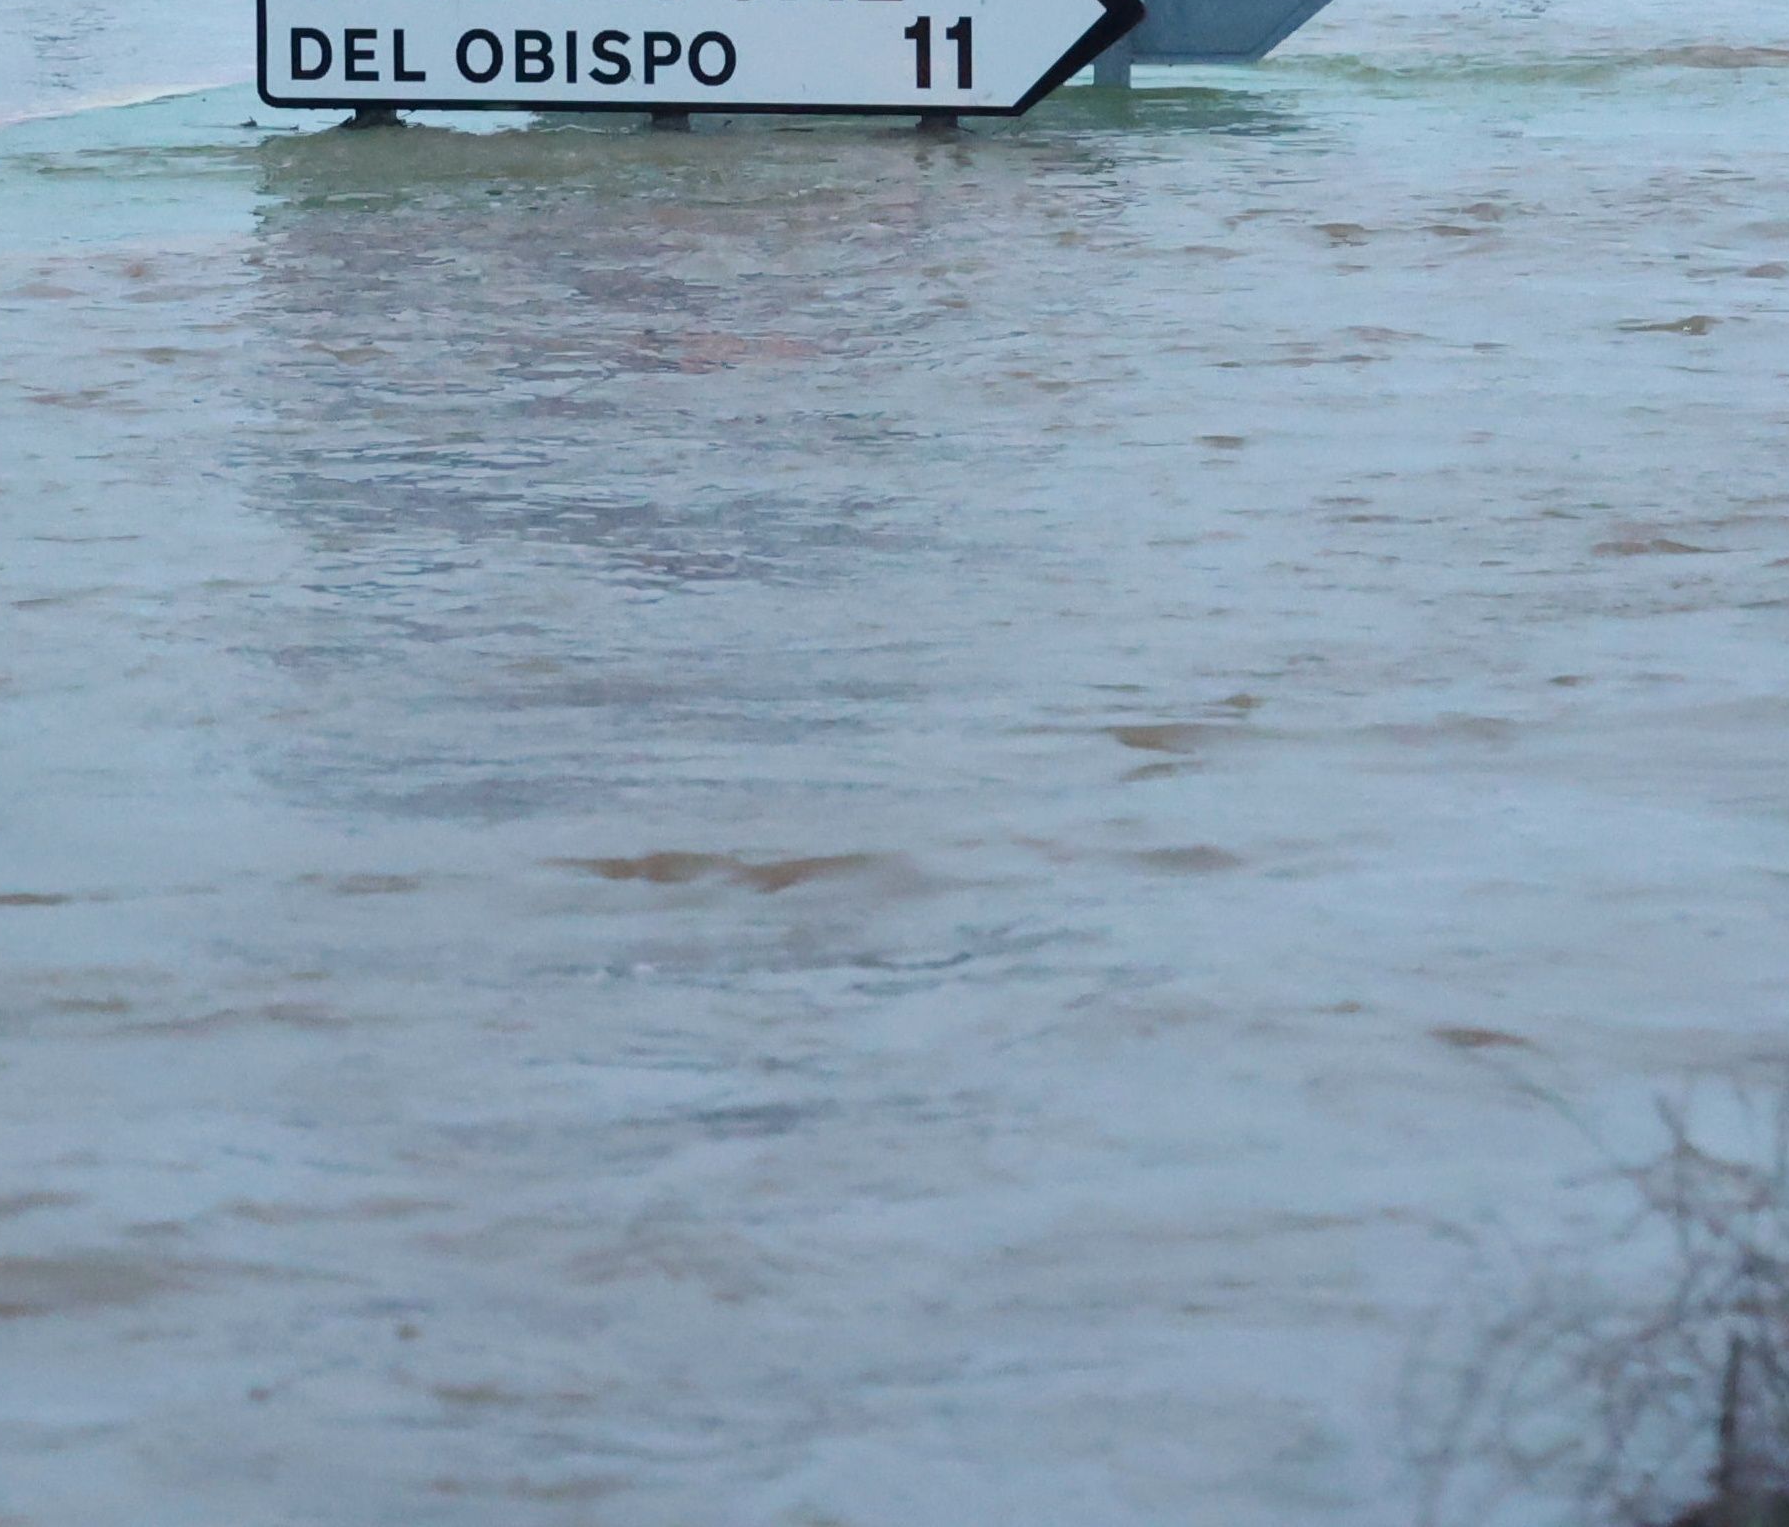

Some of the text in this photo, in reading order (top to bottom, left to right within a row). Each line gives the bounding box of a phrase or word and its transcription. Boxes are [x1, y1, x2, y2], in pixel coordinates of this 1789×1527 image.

[291, 28, 736, 86] DEL OBISPO
[905, 16, 972, 89] 11
